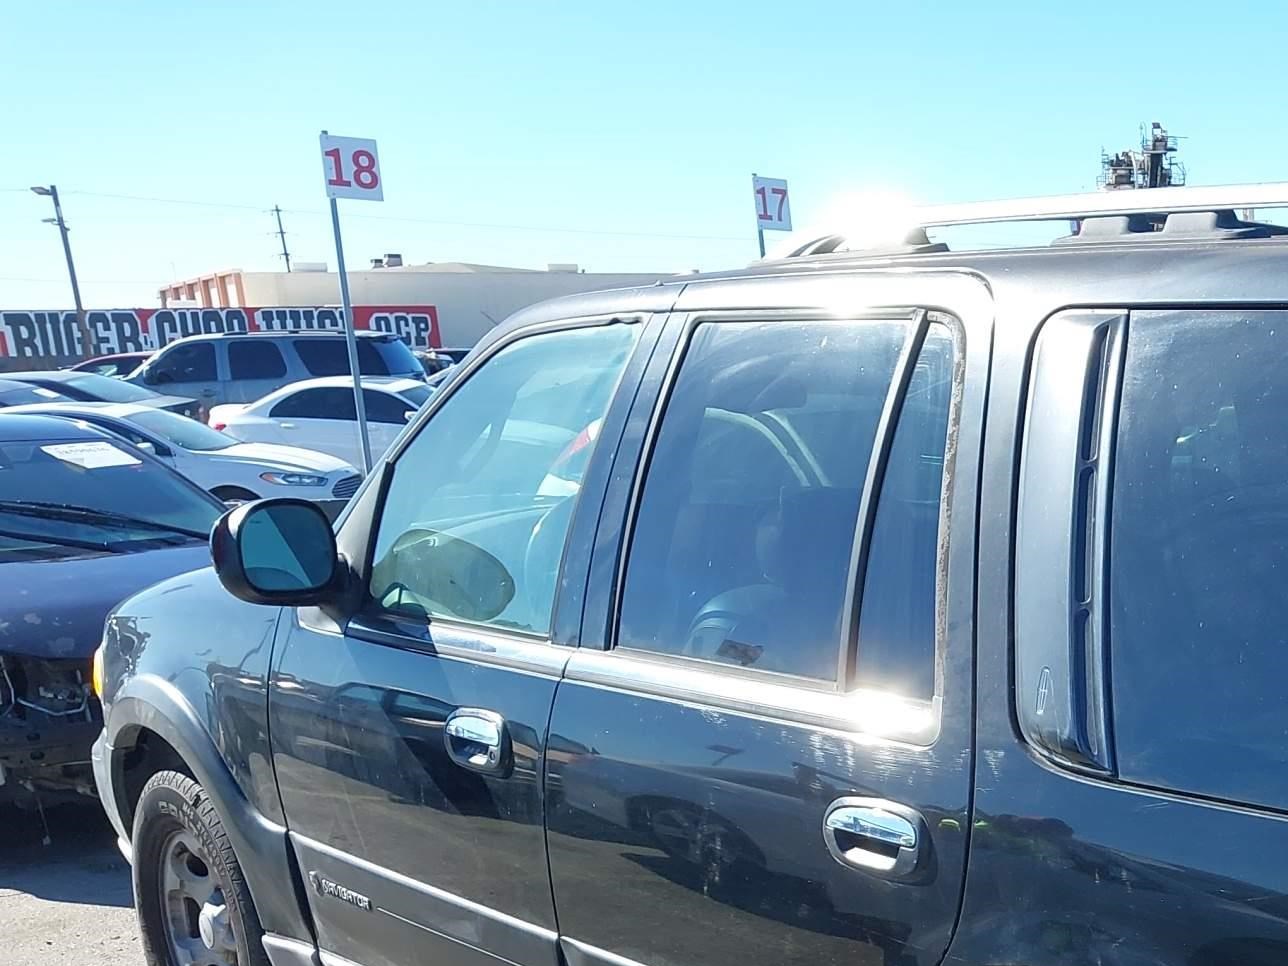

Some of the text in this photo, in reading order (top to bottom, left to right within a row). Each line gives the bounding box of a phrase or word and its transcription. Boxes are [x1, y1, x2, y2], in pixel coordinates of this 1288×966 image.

[324, 147, 379, 190] 18
[756, 186, 787, 222] 17
[321, 878, 371, 911] NAVIGATOR
